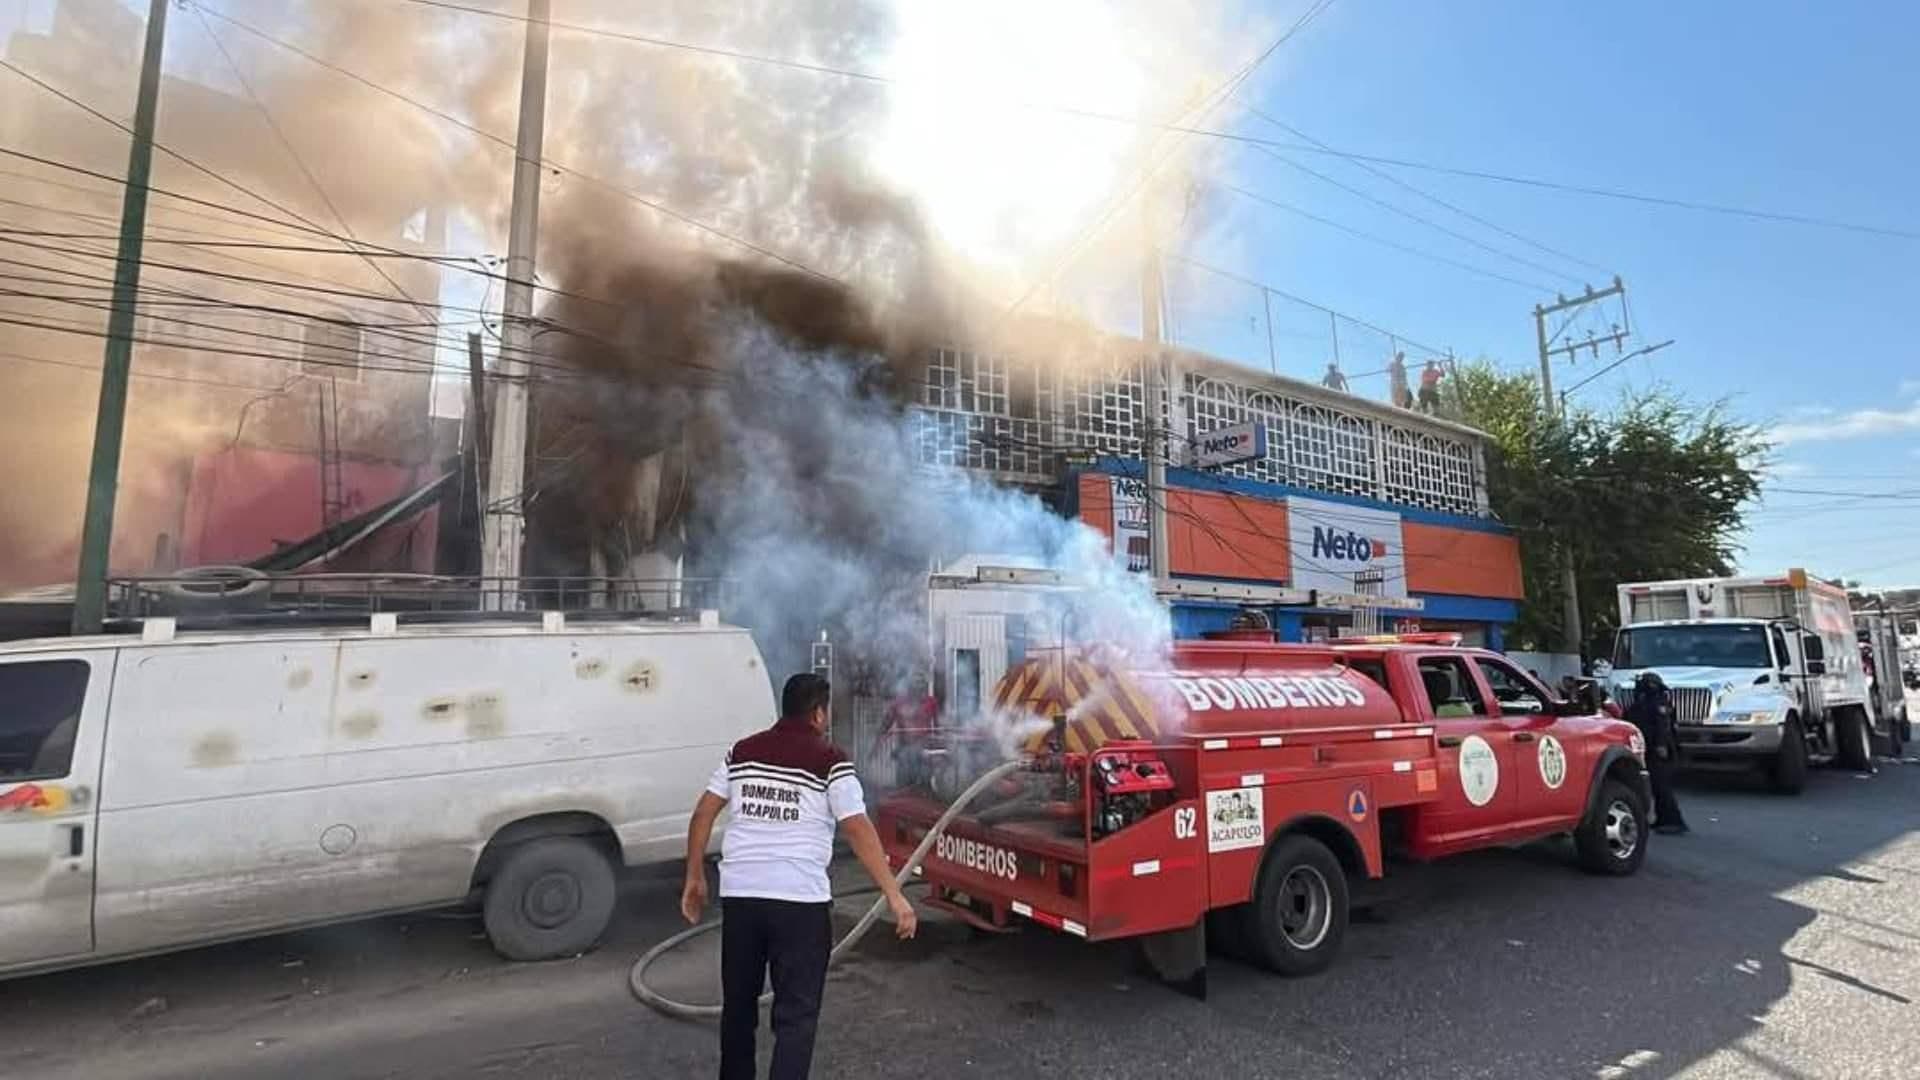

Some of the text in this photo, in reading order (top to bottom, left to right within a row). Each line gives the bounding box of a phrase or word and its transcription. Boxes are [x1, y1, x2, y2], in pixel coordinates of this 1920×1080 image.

[1204, 435, 1238, 455] Neto
[1312, 526, 1371, 561] Neto
[1171, 677, 1365, 711] BOMBEROS
[742, 784, 800, 803] BOMBEROS
[742, 802, 799, 821] ACAPULCO
[1175, 807, 1197, 839] 62
[1212, 825, 1261, 842] ACAPULCO
[936, 831, 1018, 881] BOMBEROS
